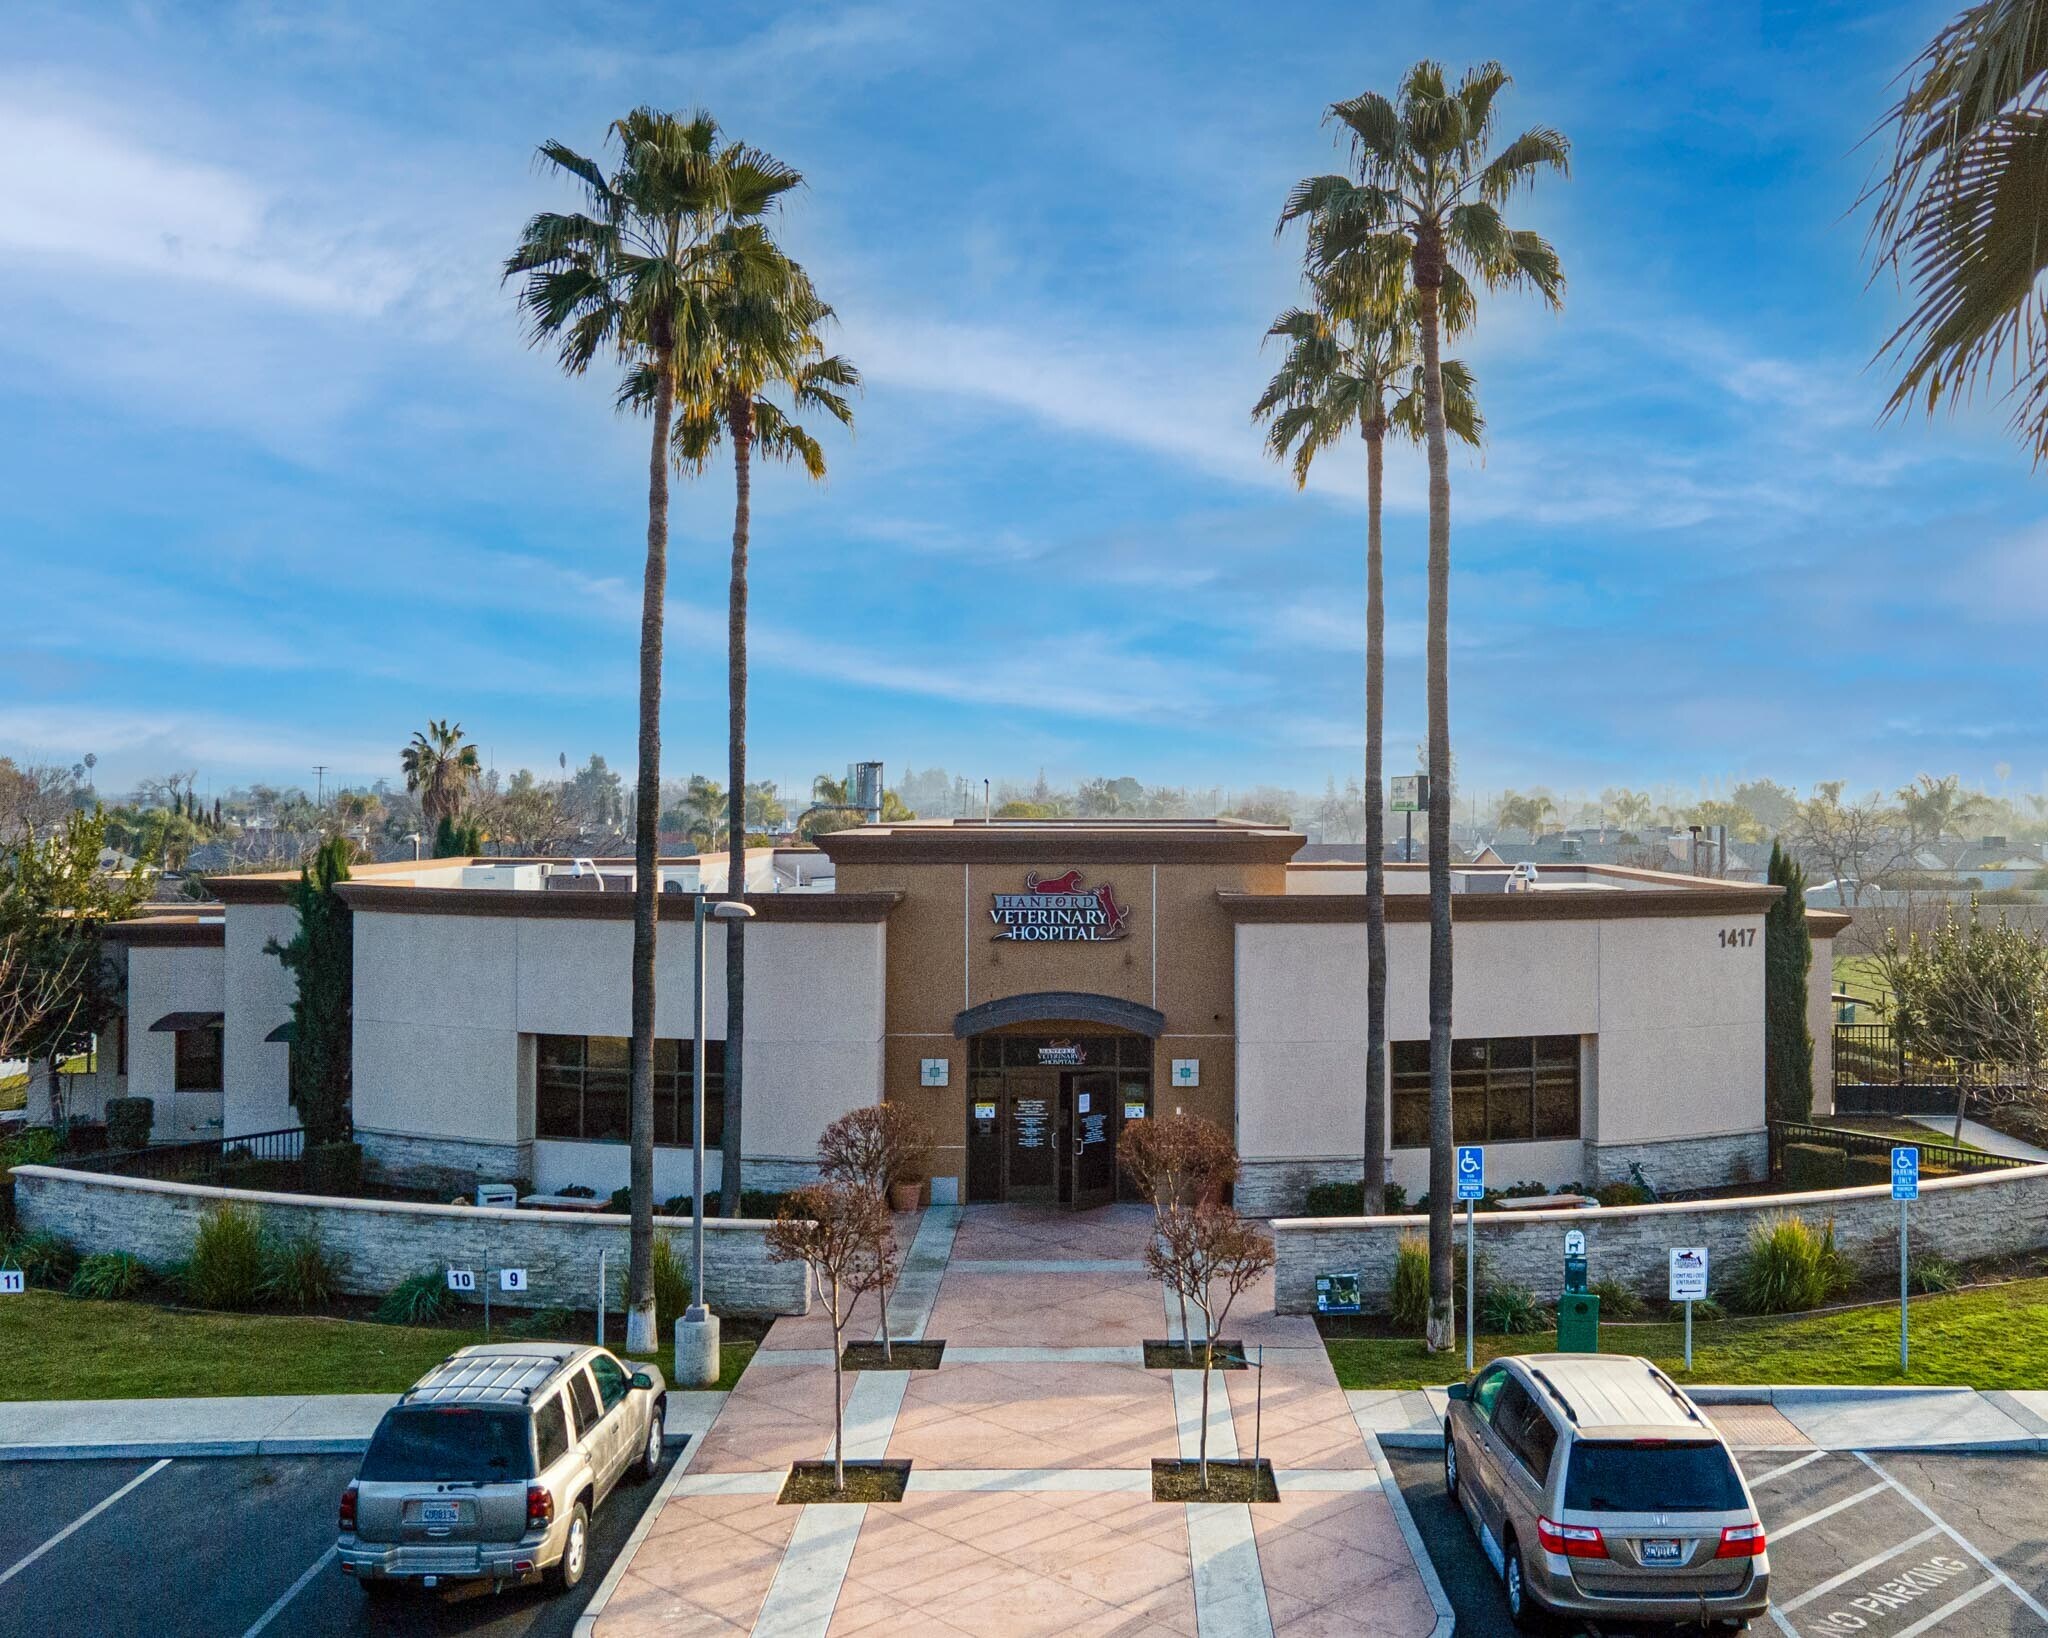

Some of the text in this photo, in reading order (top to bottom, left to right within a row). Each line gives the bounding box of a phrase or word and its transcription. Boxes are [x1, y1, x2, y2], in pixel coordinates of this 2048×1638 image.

[1002, 896, 1095, 908] HANFORD
[990, 910, 1107, 924] VETERINARY
[1011, 925, 1101, 941] HOSPITAL
[1718, 928, 1757, 948] 1417
[1893, 1169, 1917, 1177] PARKING
[4, 1274, 20, 1289] 11
[453, 1273, 471, 1287] 10
[510, 1272, 518, 1287] 9
[1807, 1556, 1968, 1638] NO PARKING
